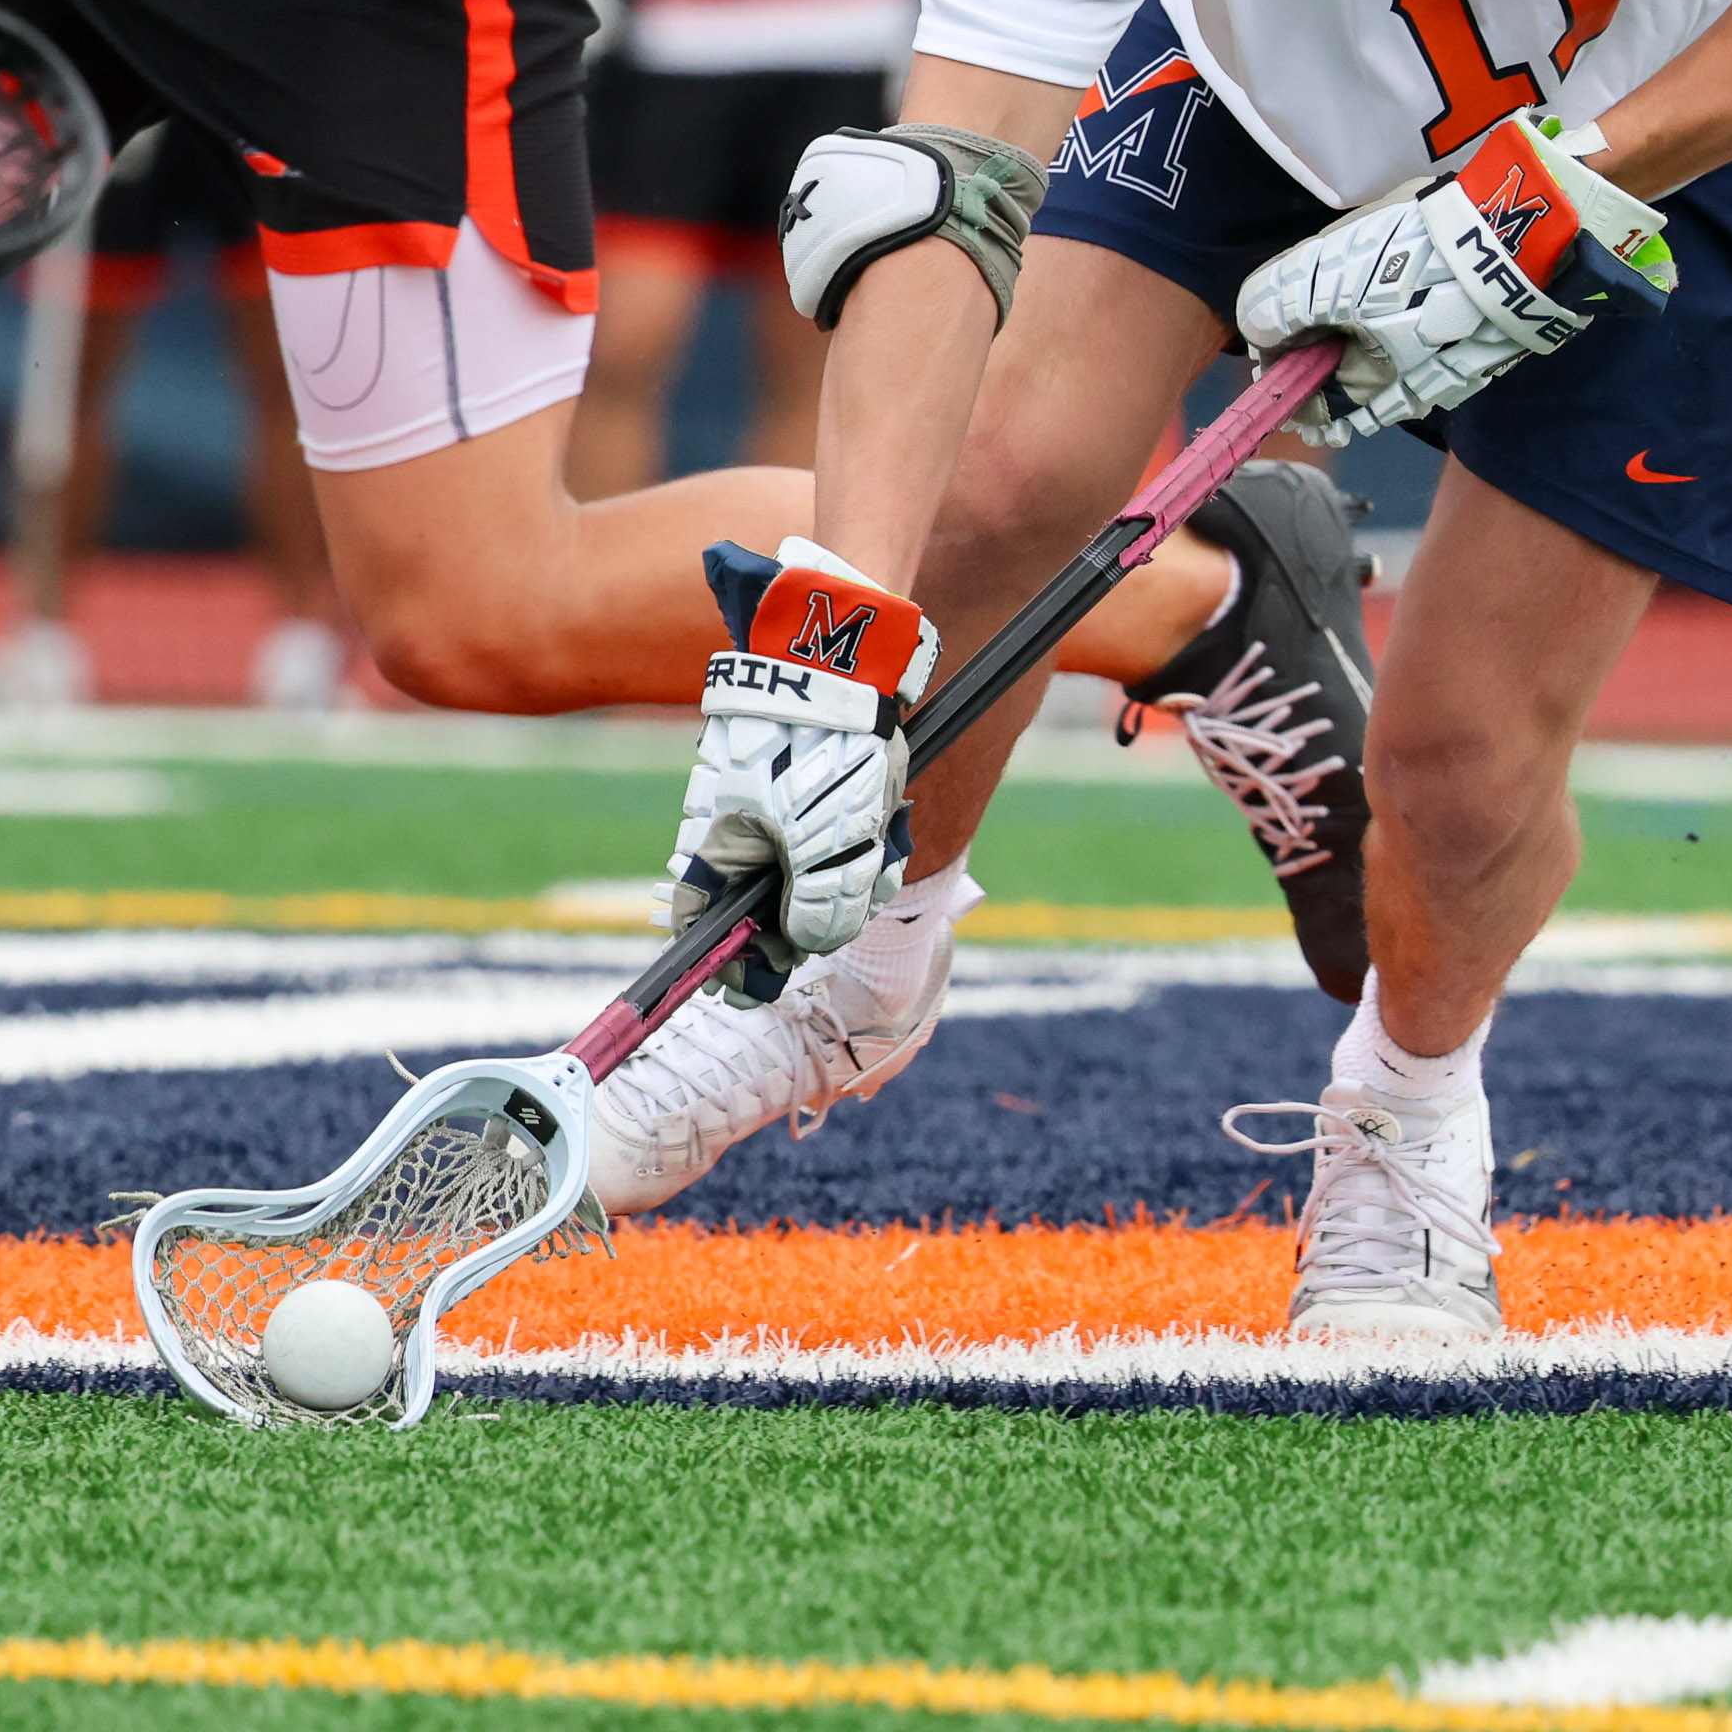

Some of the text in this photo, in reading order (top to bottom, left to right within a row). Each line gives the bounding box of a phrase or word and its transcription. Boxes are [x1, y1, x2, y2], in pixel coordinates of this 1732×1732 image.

[1475, 162, 1552, 258] M
[1612, 229, 1649, 261] 11
[1456, 225, 1576, 347] MAVE
[789, 590, 877, 675] M
